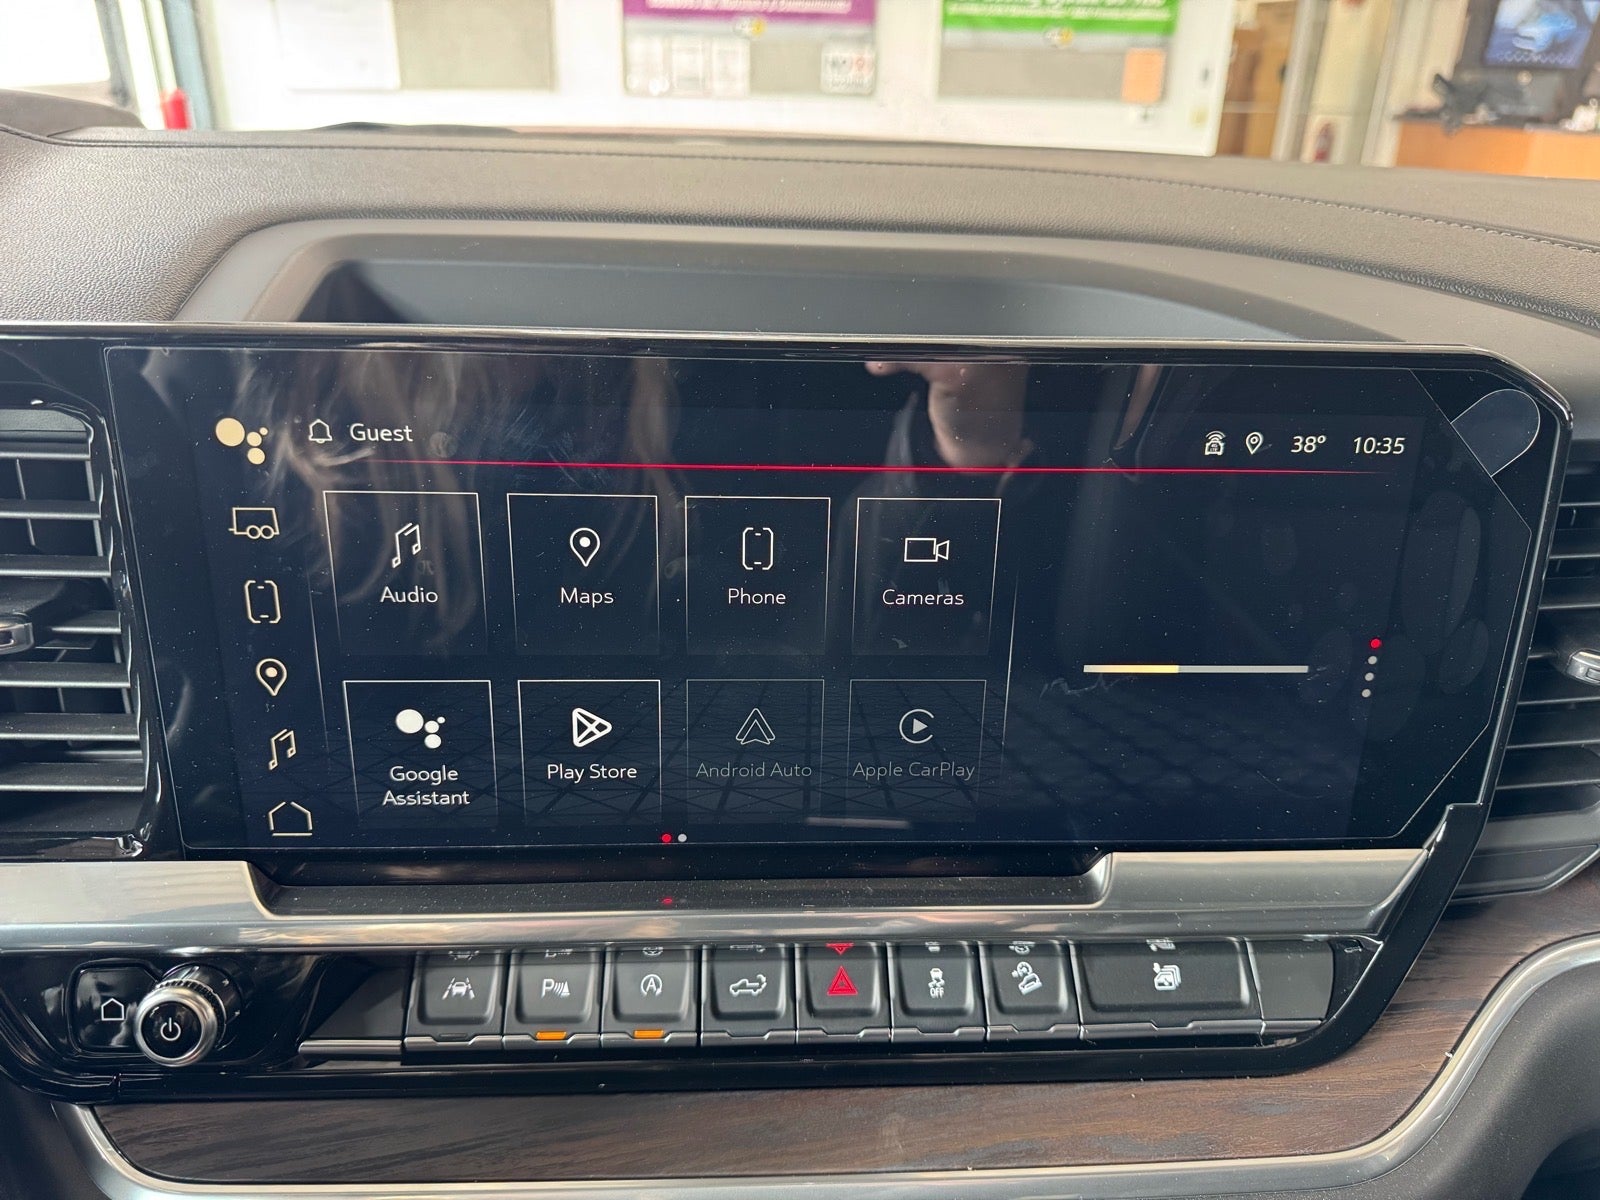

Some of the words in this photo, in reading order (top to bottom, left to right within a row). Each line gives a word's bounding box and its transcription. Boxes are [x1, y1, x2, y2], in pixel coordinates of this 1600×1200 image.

[349, 422, 413, 442] Guest
[1352, 436, 1406, 455] 10:35
[380, 585, 439, 604] Audio
[560, 586, 614, 609] Maps
[727, 587, 787, 605] Phone
[882, 588, 965, 606] Cameras
[389, 764, 459, 786] Google
[546, 763, 585, 784] Play
[589, 763, 638, 780] Store
[695, 761, 766, 779] Android
[769, 761, 813, 778] Auto
[852, 760, 903, 782] Apple
[908, 760, 976, 782] CarPlay
[382, 790, 471, 807] Assistant
[928, 985, 945, 999] OFF
